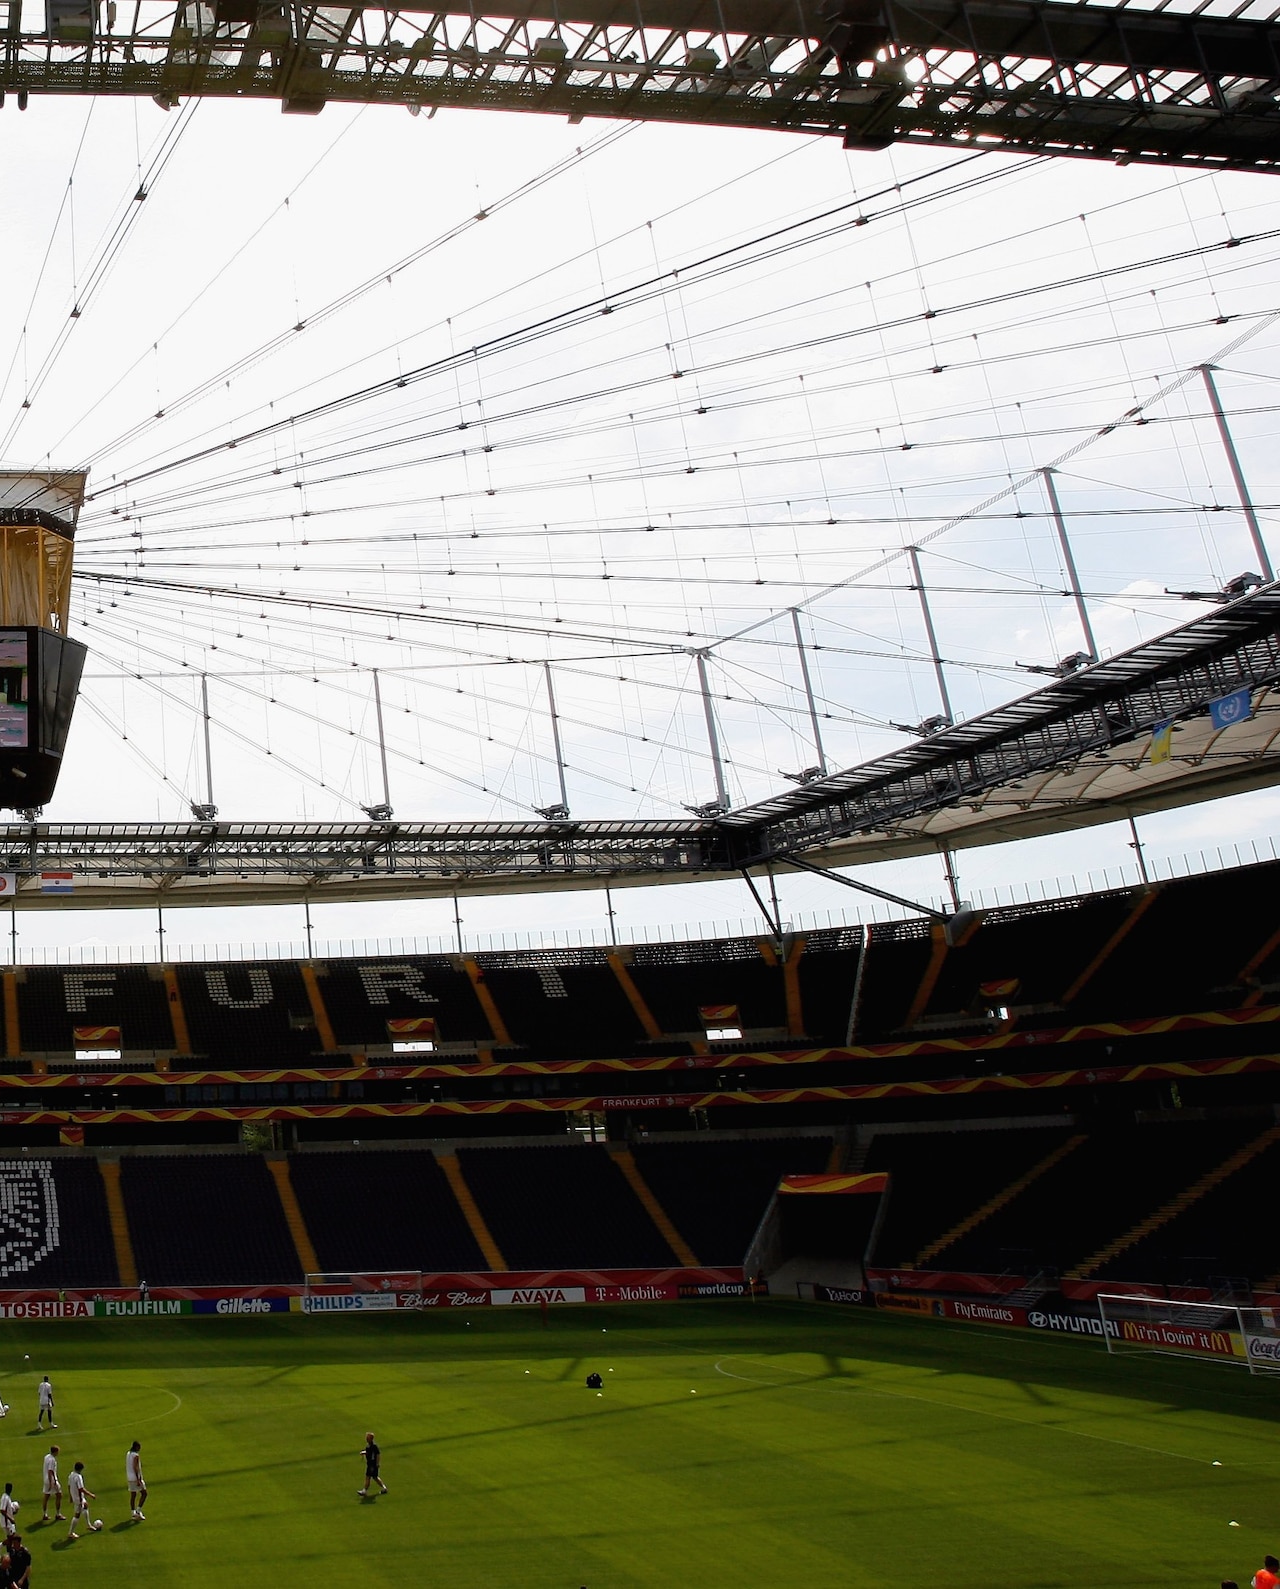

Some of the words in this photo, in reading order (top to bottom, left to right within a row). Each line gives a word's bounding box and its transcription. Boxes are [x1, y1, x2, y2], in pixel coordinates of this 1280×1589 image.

[603, 1097, 661, 1107] FRANKFURT
[399, 1292, 440, 1307] Bud
[447, 1292, 487, 1306] Bud
[510, 1289, 567, 1303] AVAYA
[826, 1288, 862, 1302] YAHOO!
[0, 1302, 88, 1316] TOSHIBA
[106, 1300, 181, 1315] FUJIFILM
[216, 1298, 271, 1313] Gillette
[304, 1295, 363, 1310] PHILIPS
[954, 1301, 971, 1318] Fly
[971, 1303, 1013, 1322] Emirates
[1048, 1313, 1120, 1338] HYUNDAI
[1201, 1334, 1210, 1348] it
